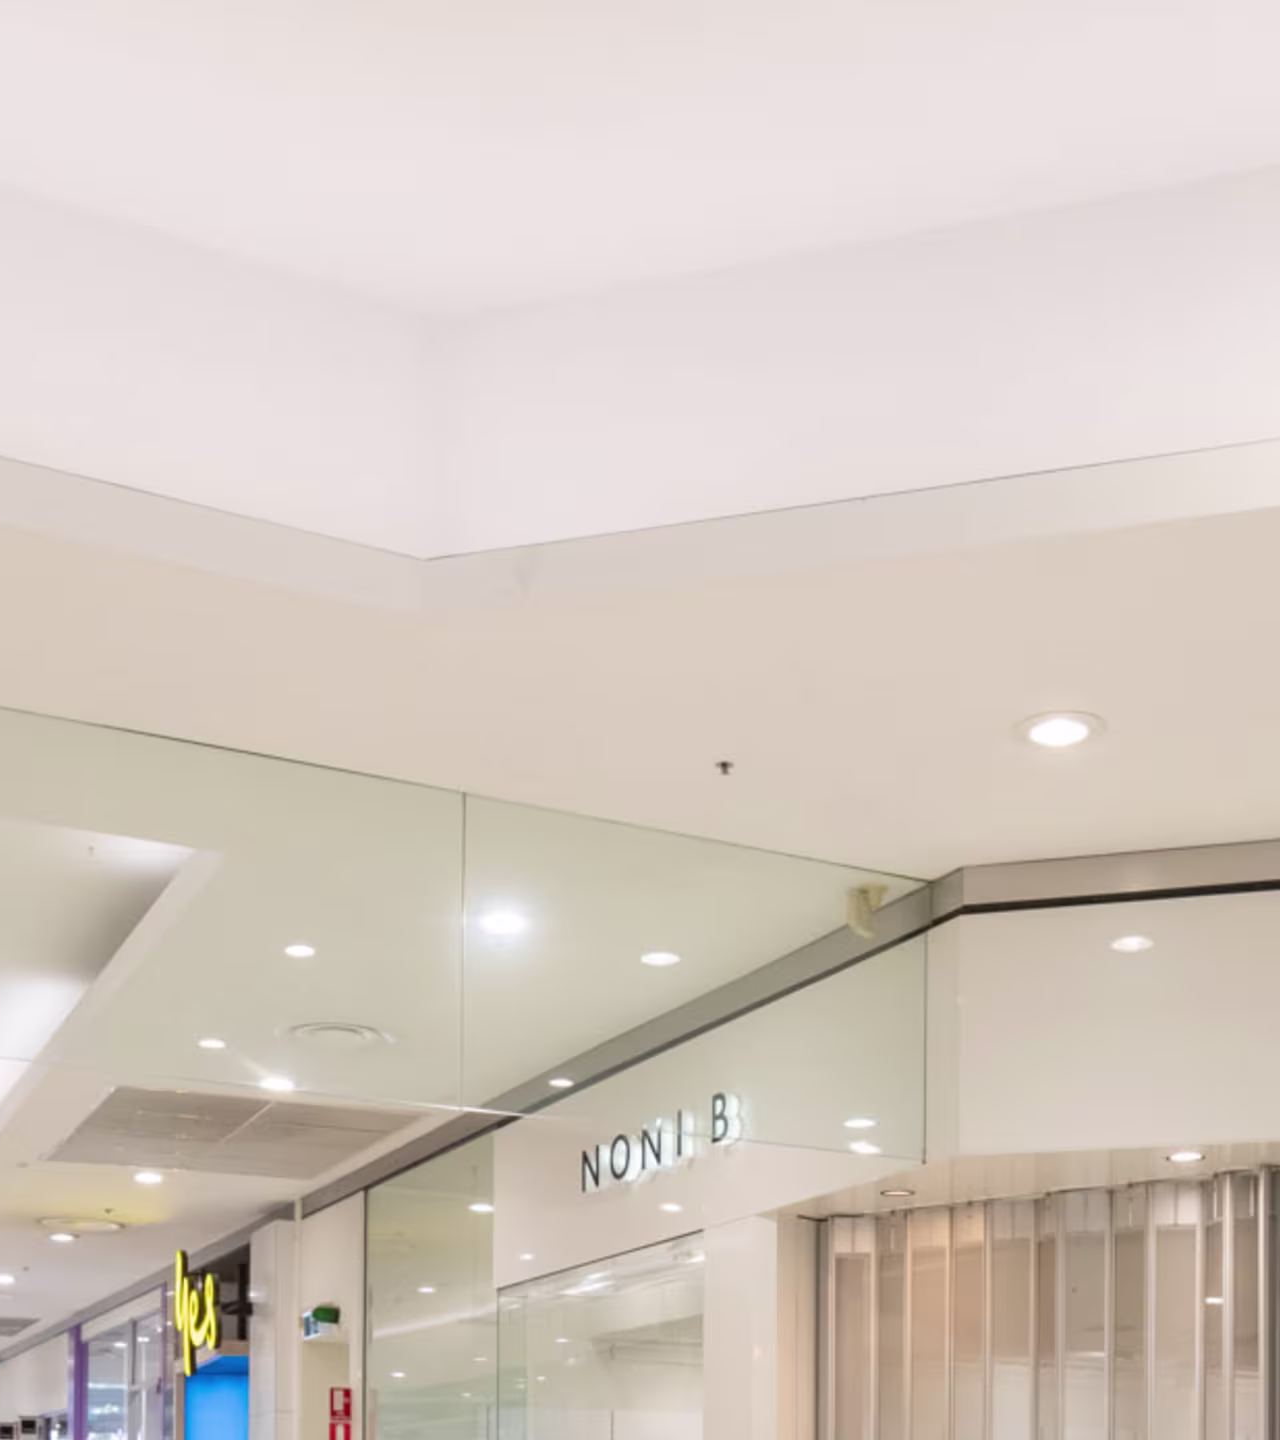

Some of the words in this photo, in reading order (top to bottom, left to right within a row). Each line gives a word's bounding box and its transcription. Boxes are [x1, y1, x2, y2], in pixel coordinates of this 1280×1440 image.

[581, 1108, 684, 1193] NONI
[711, 1092, 732, 1144] B
[174, 1249, 220, 1377] yes
